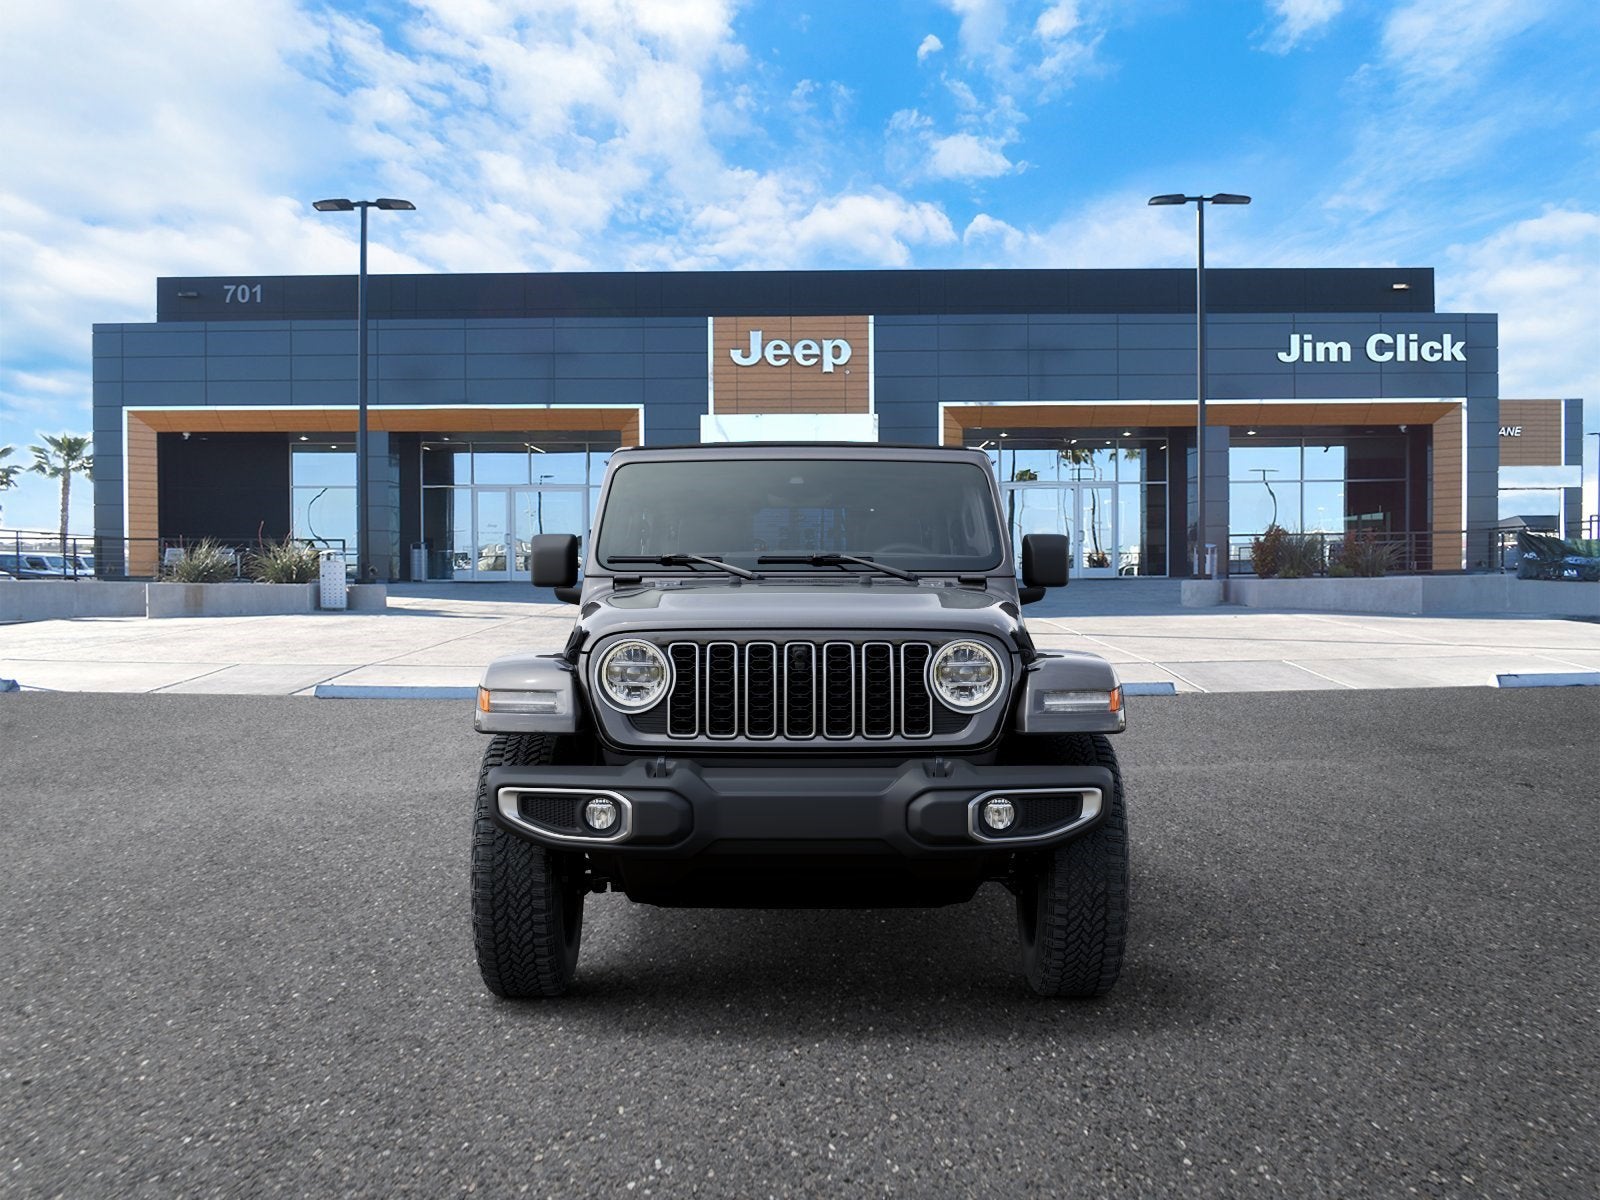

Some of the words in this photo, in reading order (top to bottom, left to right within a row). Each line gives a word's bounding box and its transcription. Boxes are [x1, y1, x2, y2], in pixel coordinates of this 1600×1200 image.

[223, 284, 262, 304] 701
[729, 330, 852, 374] Jeep
[1277, 333, 1352, 362] Jim
[1365, 333, 1467, 362] Click
